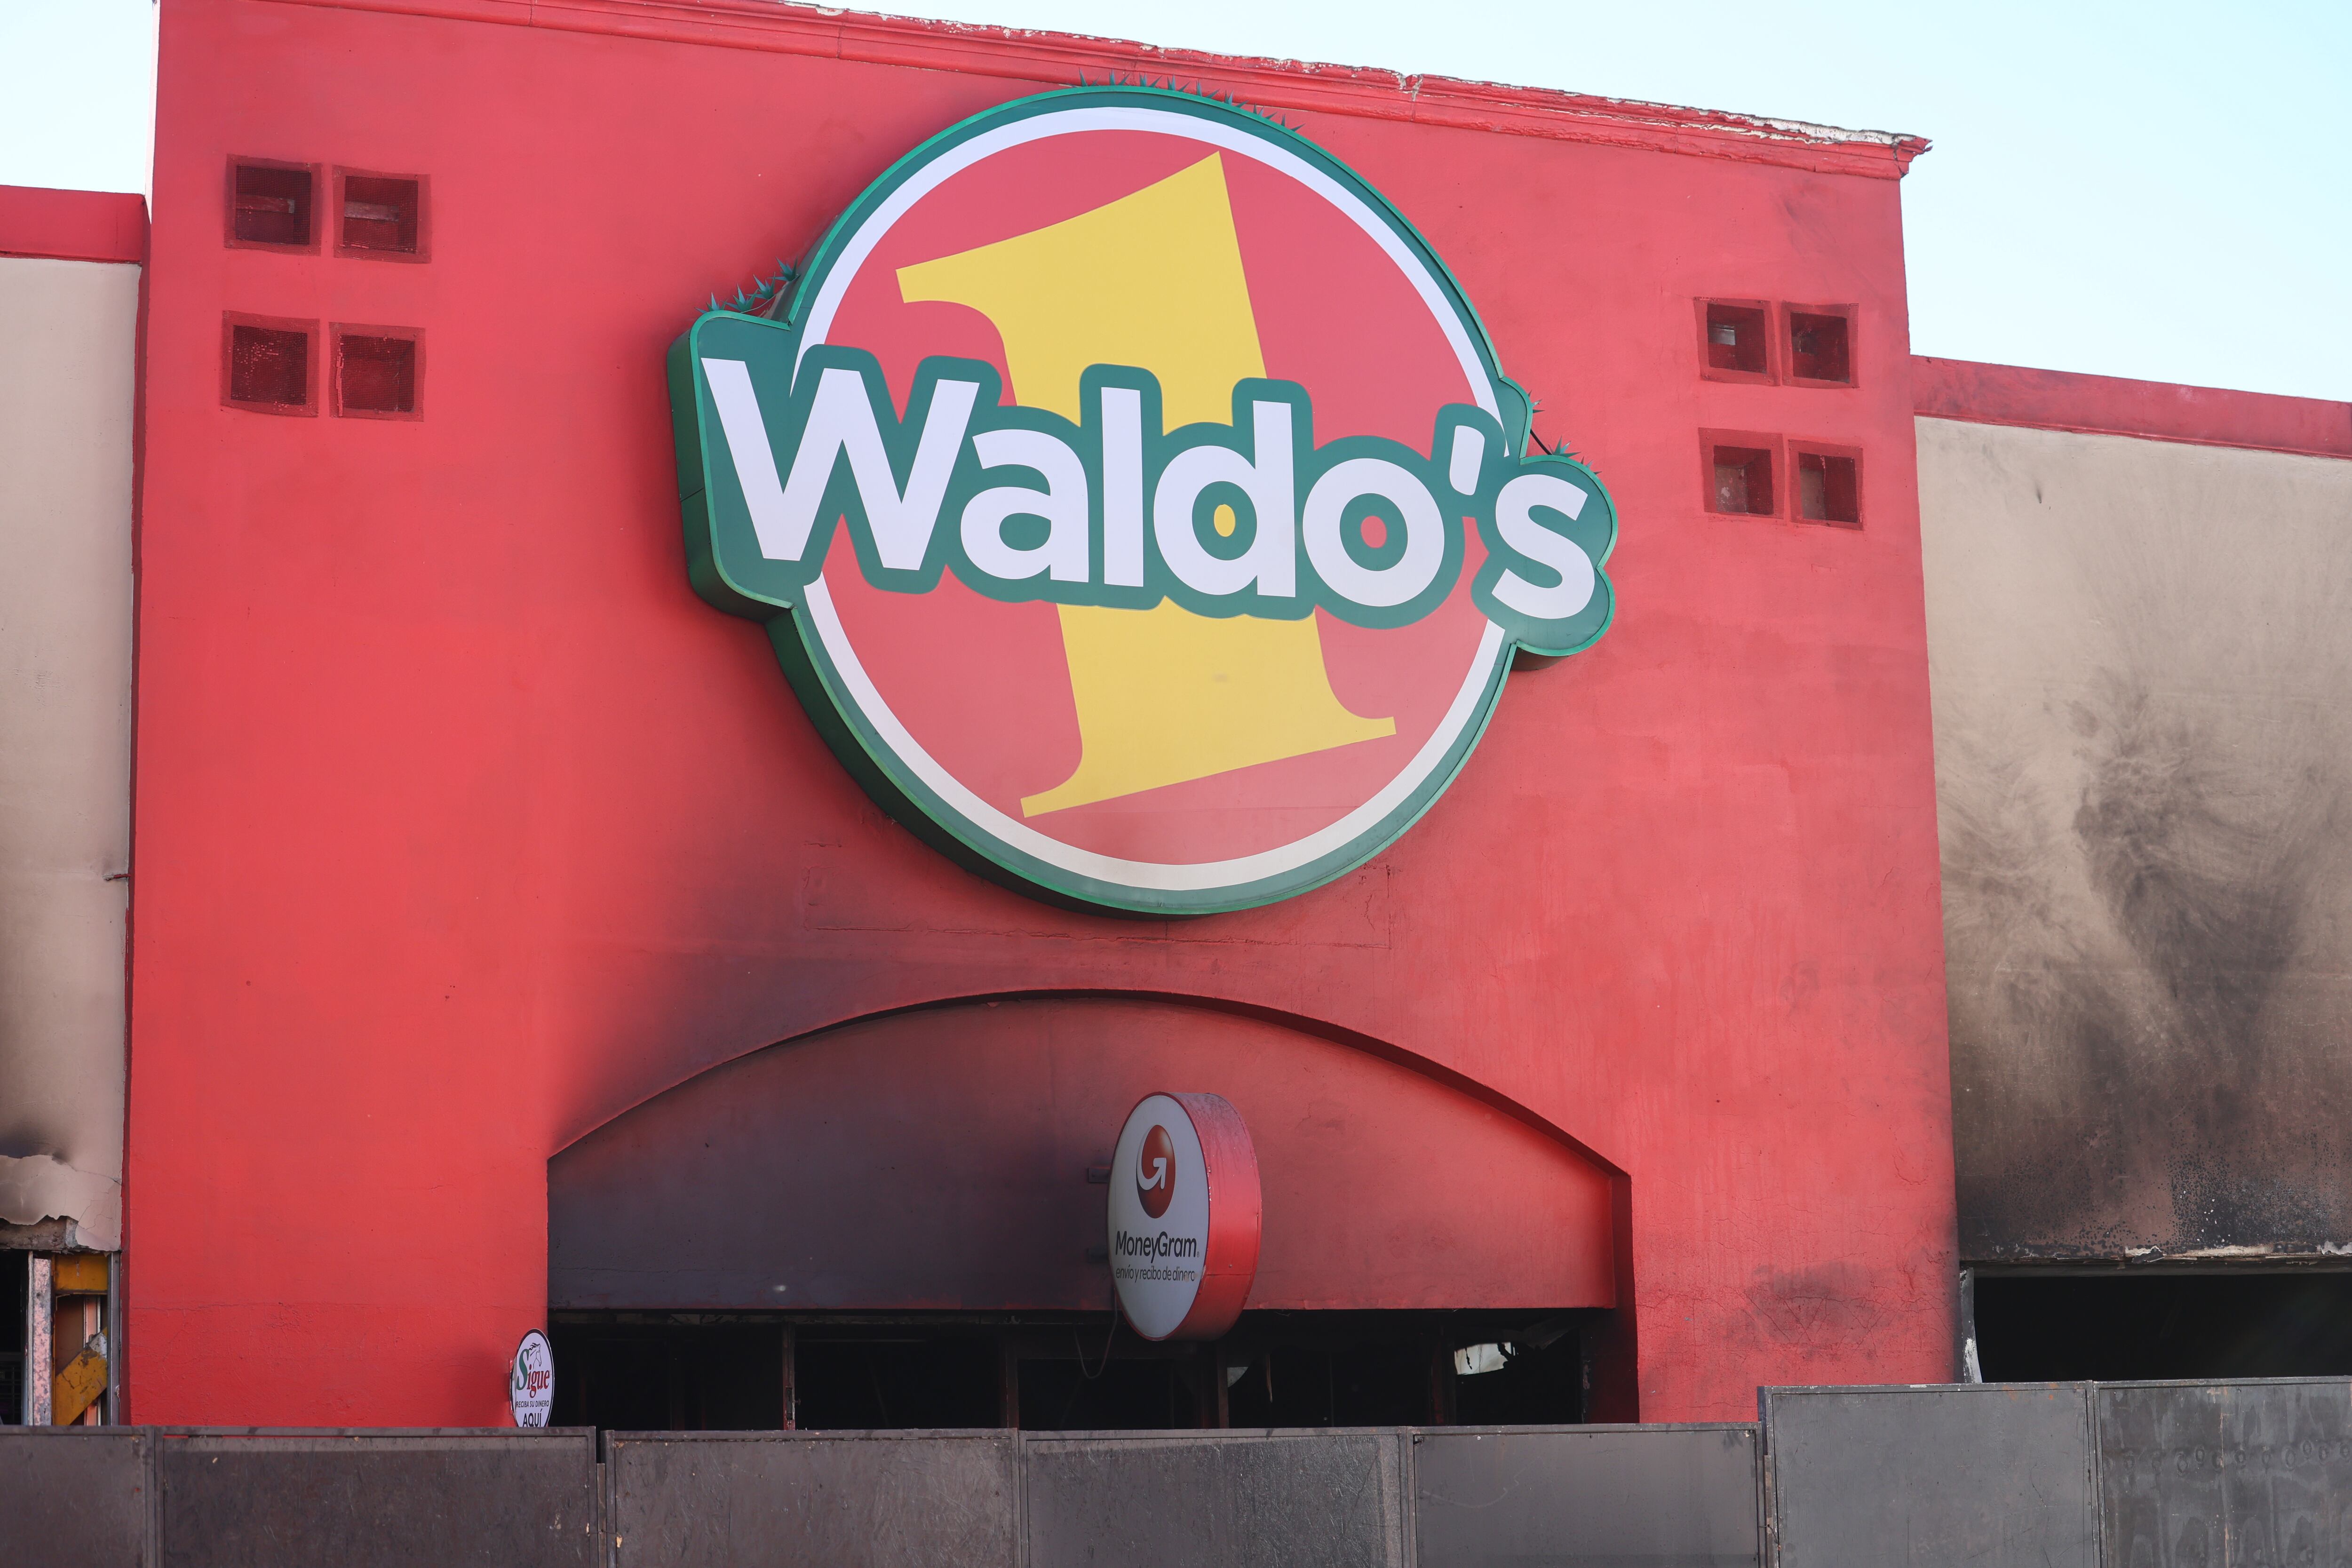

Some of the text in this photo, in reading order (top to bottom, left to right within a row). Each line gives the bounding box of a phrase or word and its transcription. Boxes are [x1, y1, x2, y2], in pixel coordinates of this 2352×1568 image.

[701, 358, 1596, 620] Waldo's
[1115, 1231, 1197, 1264] MoneyGram
[1115, 1264, 1134, 1279] envío
[1135, 1269, 1139, 1283] y
[1139, 1266, 1161, 1280] recibo
[1162, 1266, 1172, 1281] de
[516, 1349, 550, 1398] Sigue
[523, 1408, 543, 1427] AQUÍ
